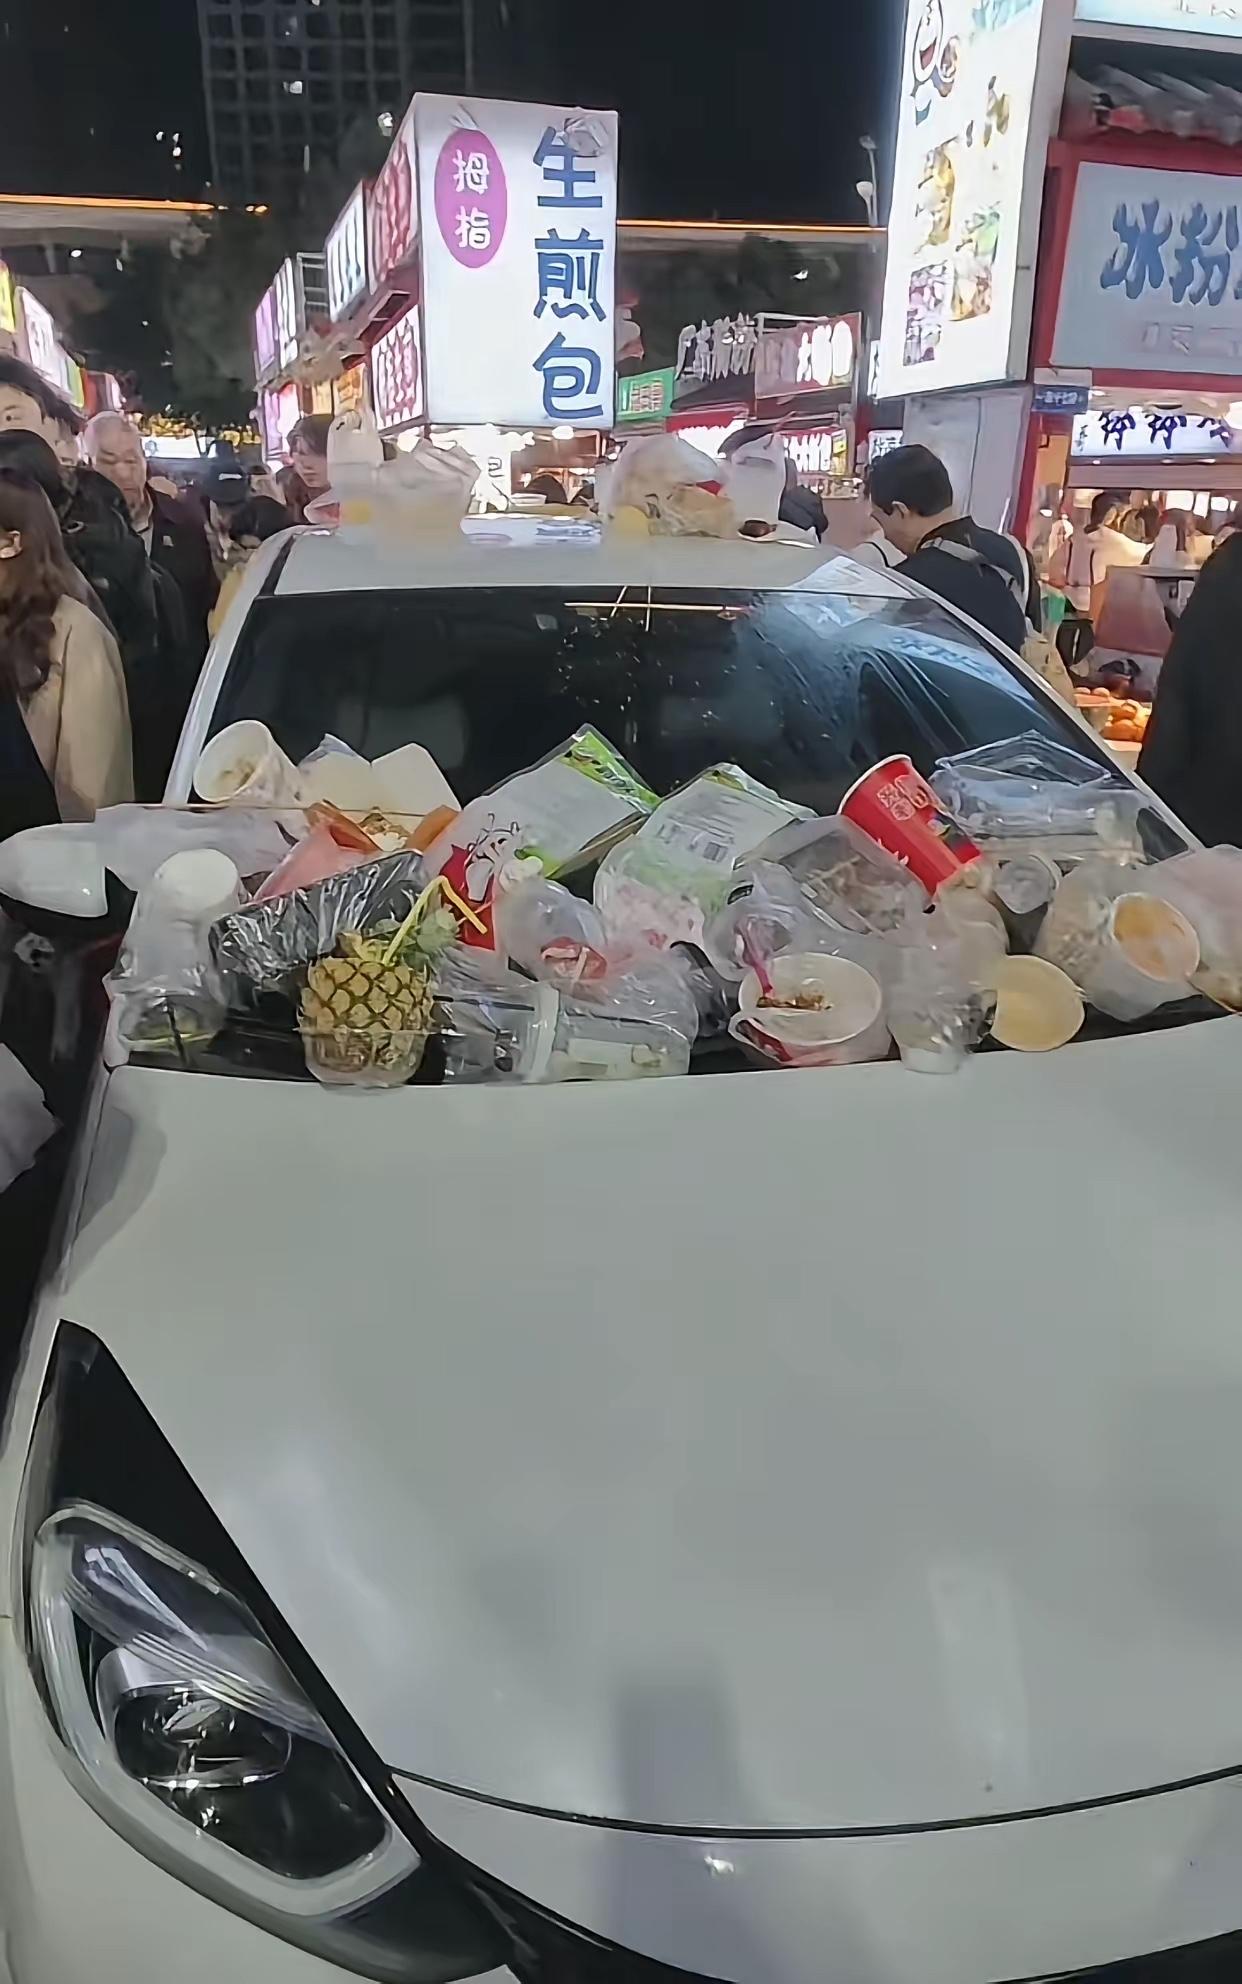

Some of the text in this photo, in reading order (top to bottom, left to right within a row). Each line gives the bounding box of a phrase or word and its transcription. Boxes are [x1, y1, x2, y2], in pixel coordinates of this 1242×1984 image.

[452, 148, 491, 250] 拇指
[1100, 198, 1242, 307] 冰粉
[532, 126, 607, 420] 生煎包
